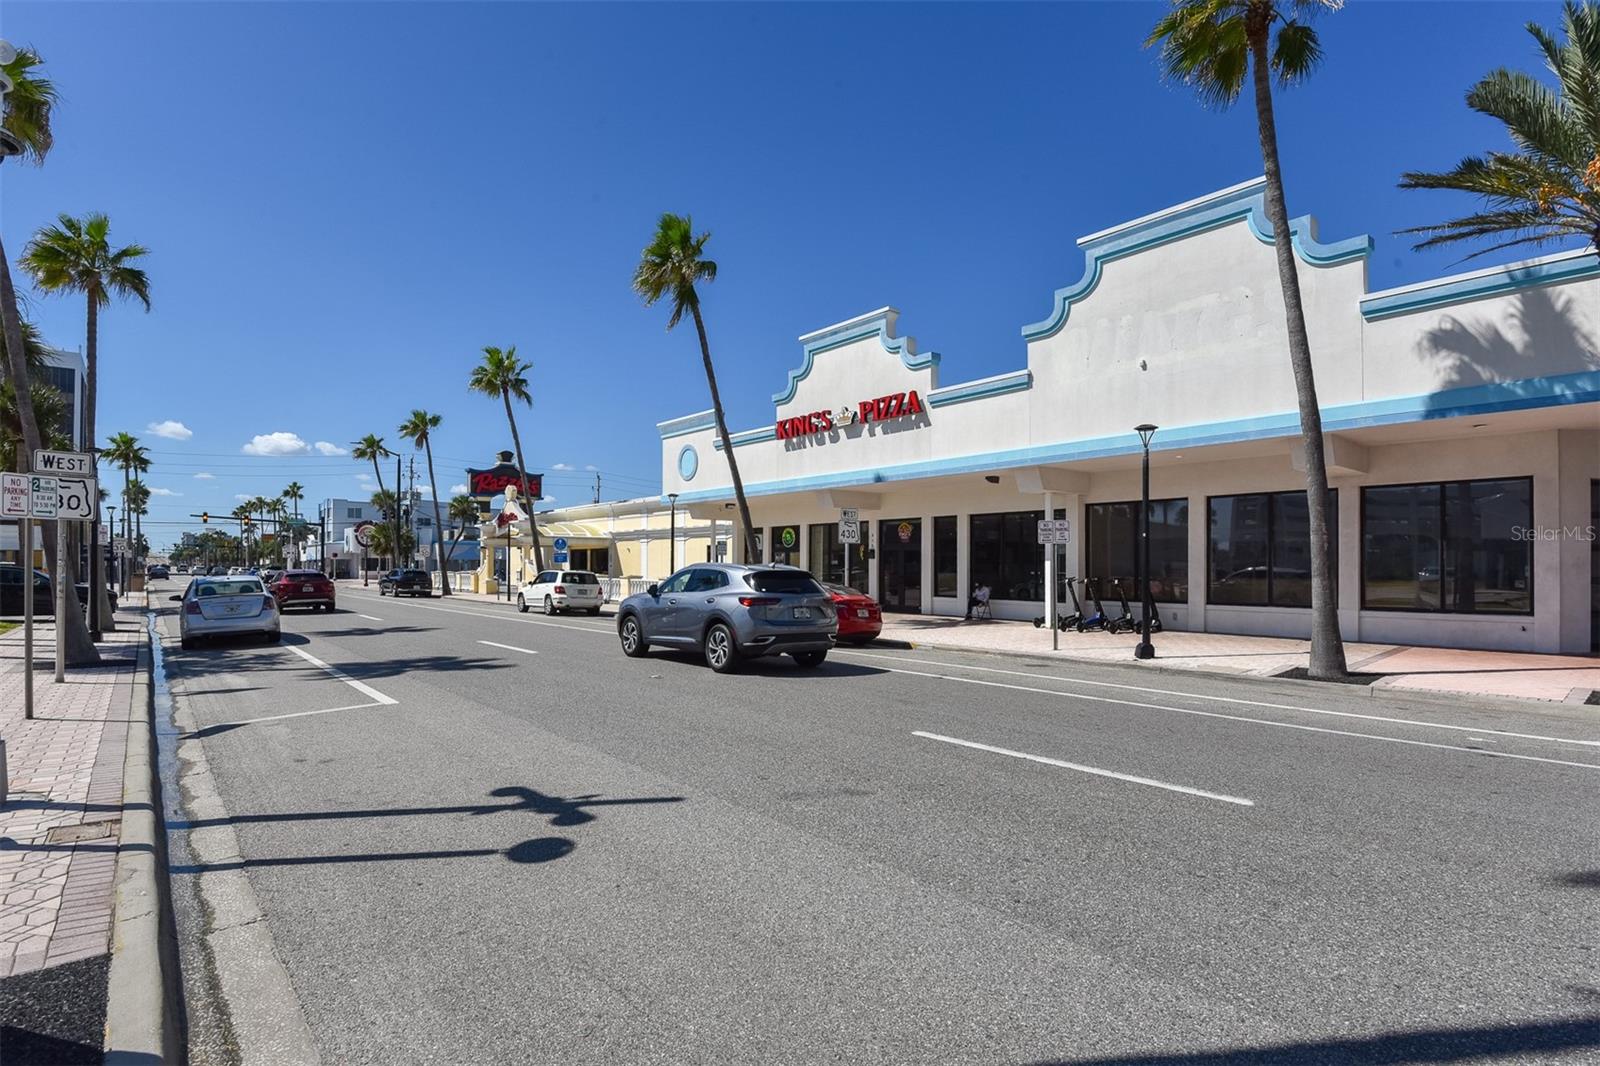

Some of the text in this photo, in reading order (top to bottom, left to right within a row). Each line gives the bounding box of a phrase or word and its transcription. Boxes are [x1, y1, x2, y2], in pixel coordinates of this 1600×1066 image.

[858, 390, 923, 424] PIZZA
[42, 454, 85, 471] WEST
[10, 478, 21, 486] NO
[33, 480, 40, 490] 2
[4, 487, 28, 496] PARKING
[841, 529, 856, 539] 430
